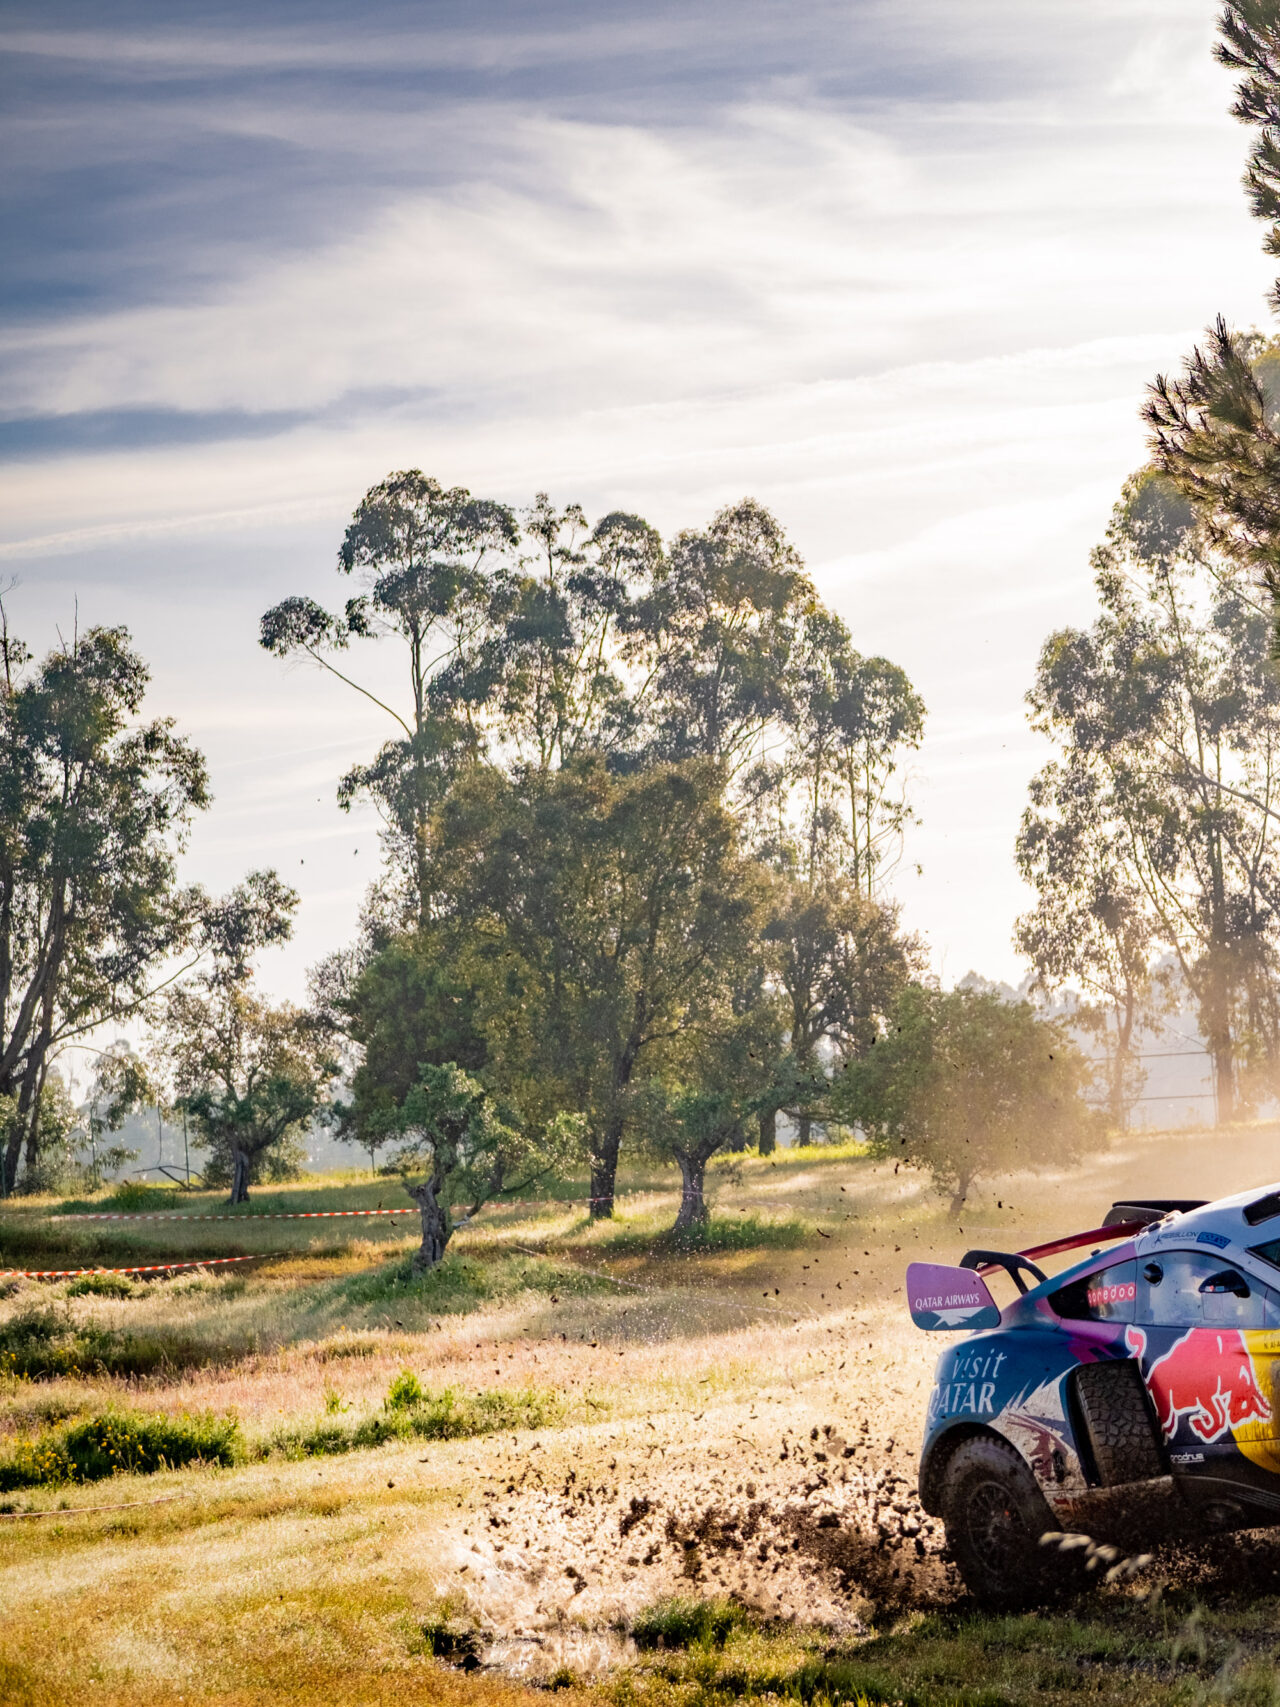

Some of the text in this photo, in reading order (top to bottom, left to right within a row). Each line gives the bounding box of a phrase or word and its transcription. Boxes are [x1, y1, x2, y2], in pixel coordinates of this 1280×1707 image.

[915, 1292, 980, 1310] QATAR AIRWAYS
[952, 1348, 1007, 1380] visit
[929, 1382, 995, 1422] QATAR
